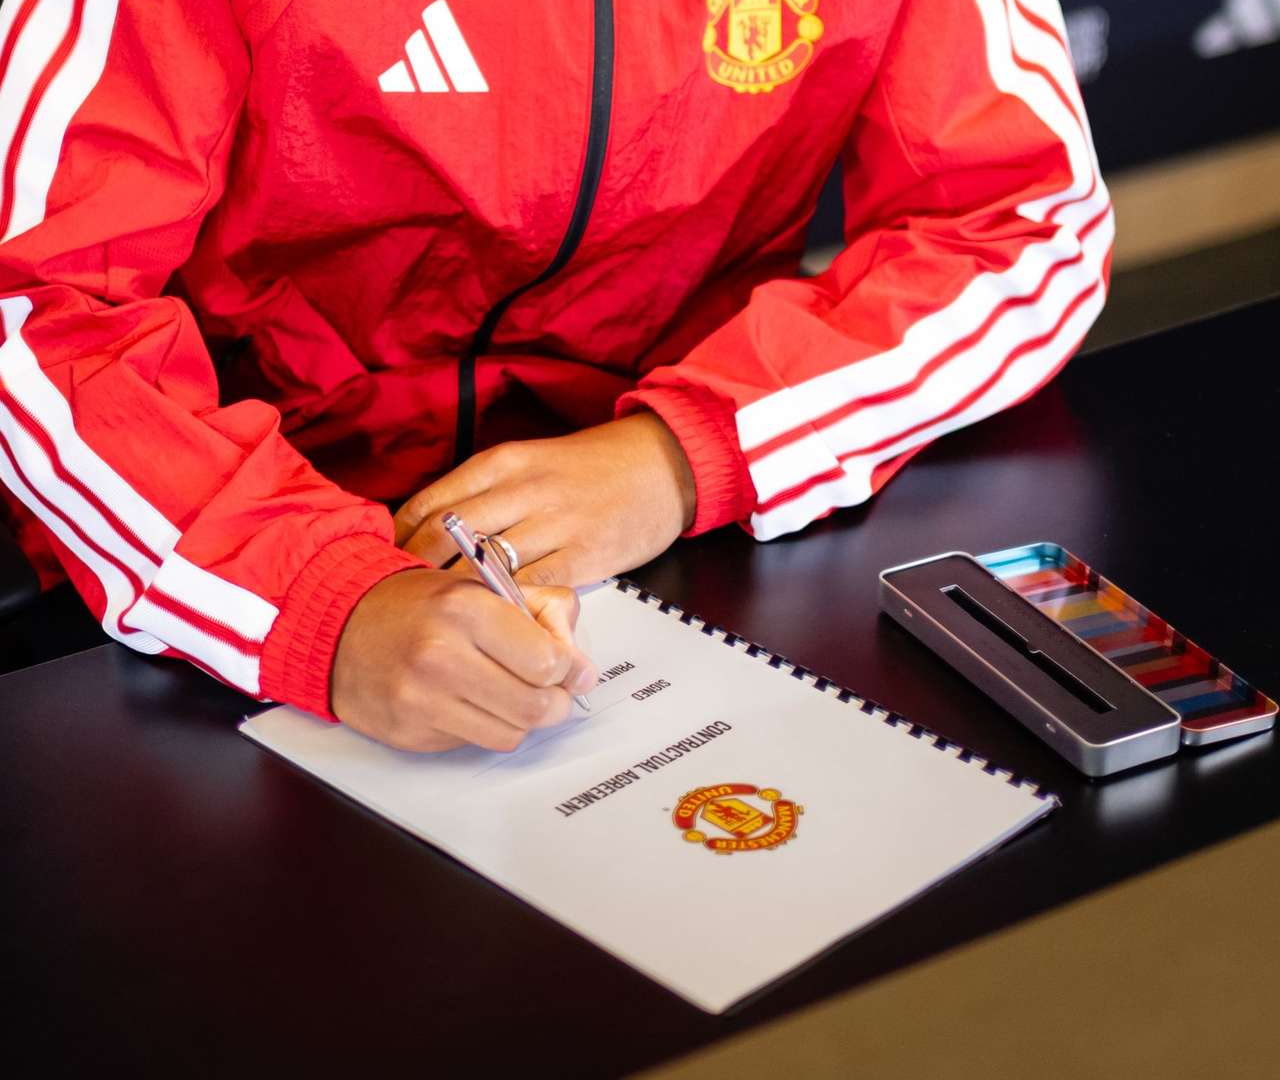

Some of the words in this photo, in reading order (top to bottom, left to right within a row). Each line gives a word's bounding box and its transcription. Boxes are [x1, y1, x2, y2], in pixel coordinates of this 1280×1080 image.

[719, 58, 795, 83] UNITED
[602, 661, 636, 681] PRINT
[631, 679, 671, 701] SIGNED
[633, 720, 732, 773] CONTRACTUAL
[555, 769, 641, 817] AGREEMENT
[679, 786, 733, 818] UNITED
[716, 805, 793, 850] MANCHESTER
